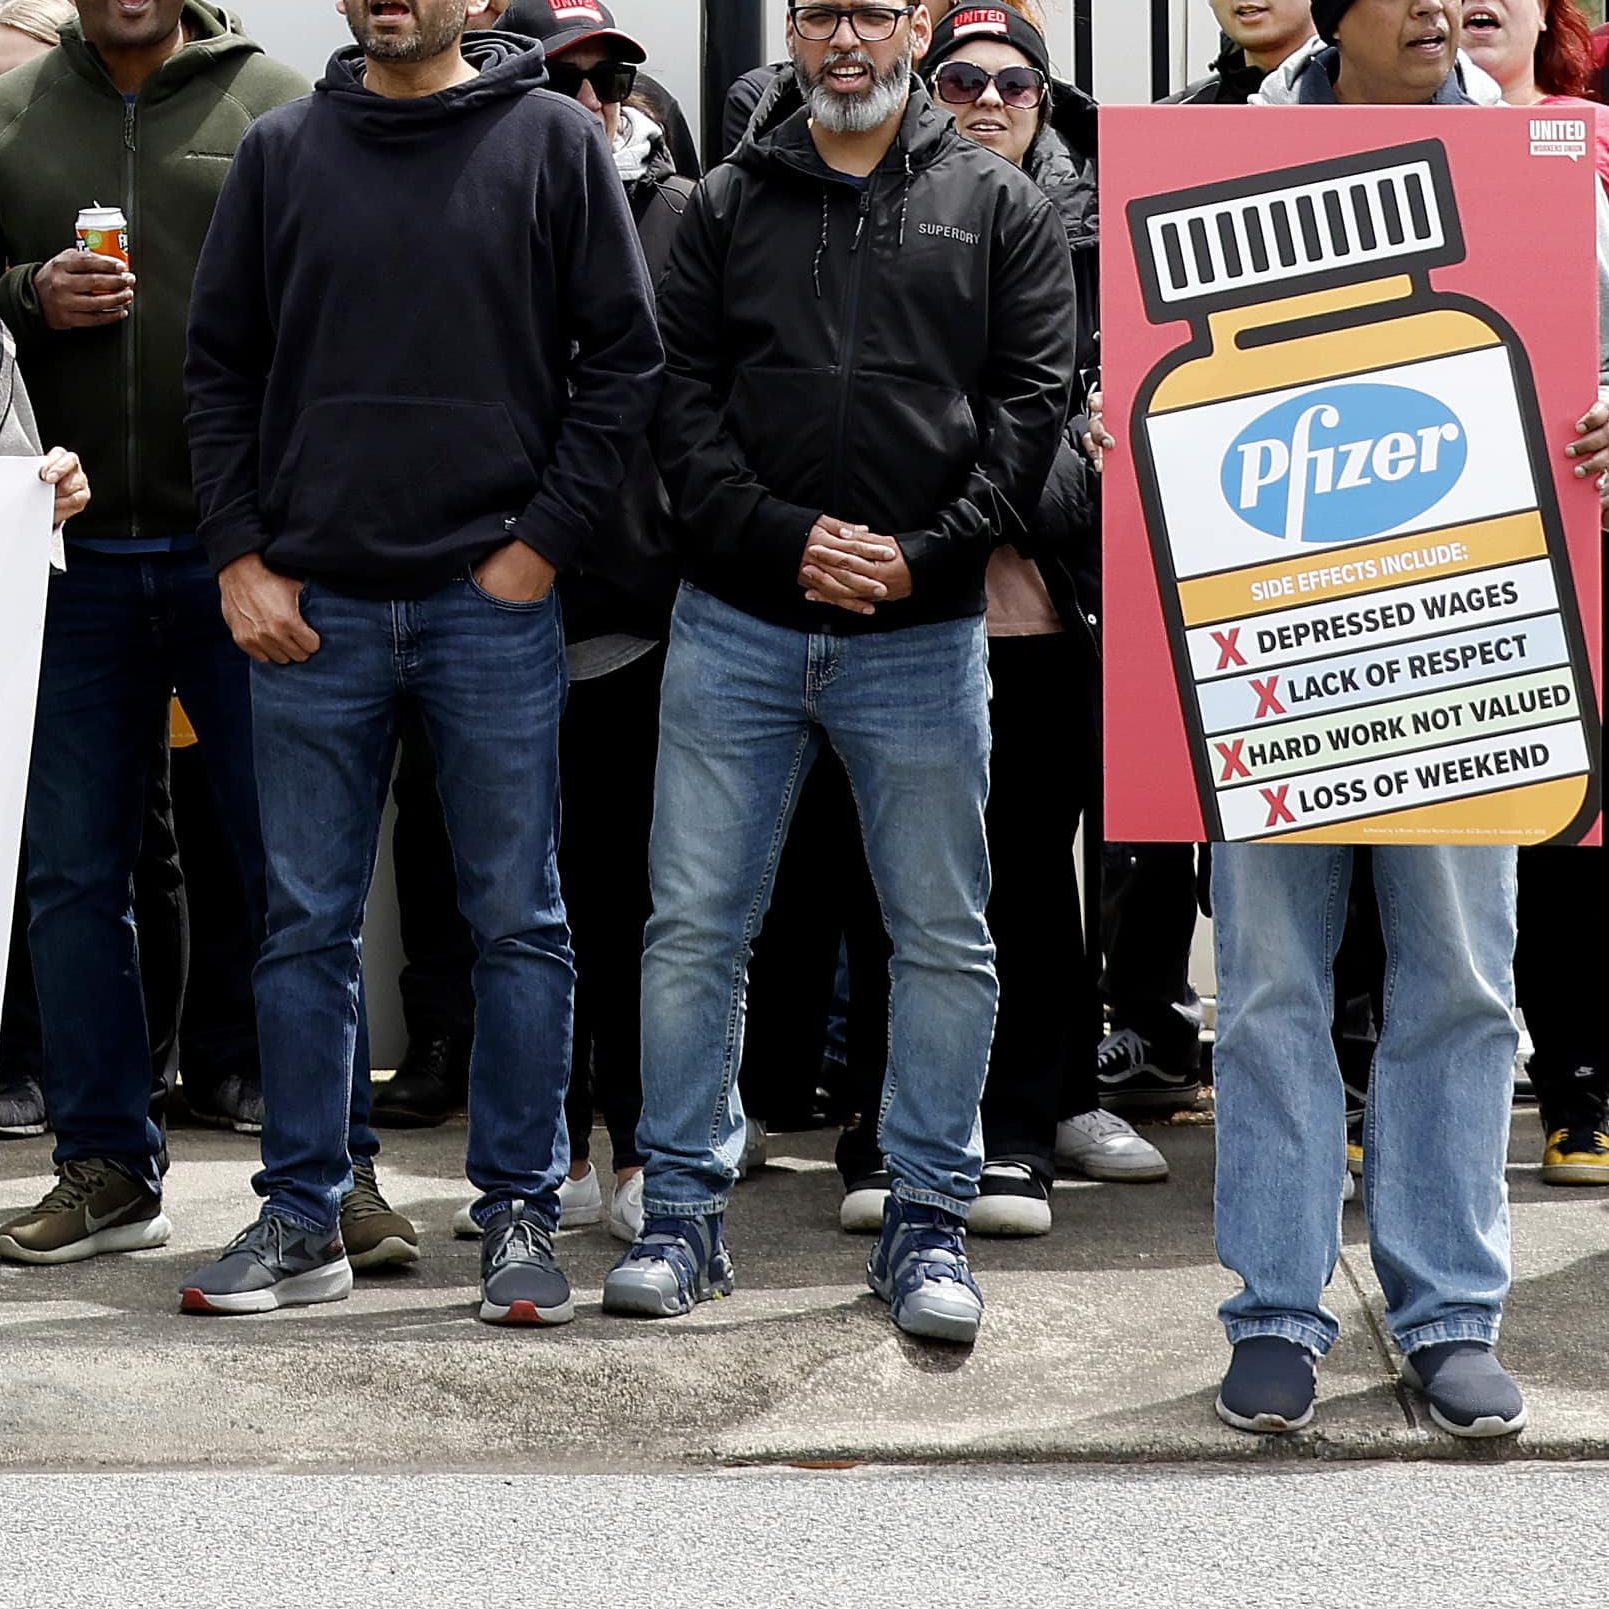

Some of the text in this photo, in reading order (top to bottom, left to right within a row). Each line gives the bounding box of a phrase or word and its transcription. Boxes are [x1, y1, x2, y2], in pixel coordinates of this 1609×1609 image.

[953, 9, 1006, 27] UNITED
[1530, 120, 1586, 140] UNITED
[919, 223, 980, 244] SUPERDRY
[1237, 404, 1459, 543] Pfizer
[1251, 542, 1469, 602] SIDE EFFECTS INCLUDE:
[1256, 580, 1519, 654] DEPRESSED WAGES
[1287, 634, 1527, 704] LACK OF RESPECT
[1247, 684, 1571, 768] HARD WORK NOT VALUED
[1298, 743, 1550, 814] LOSS OF WEEKEND
